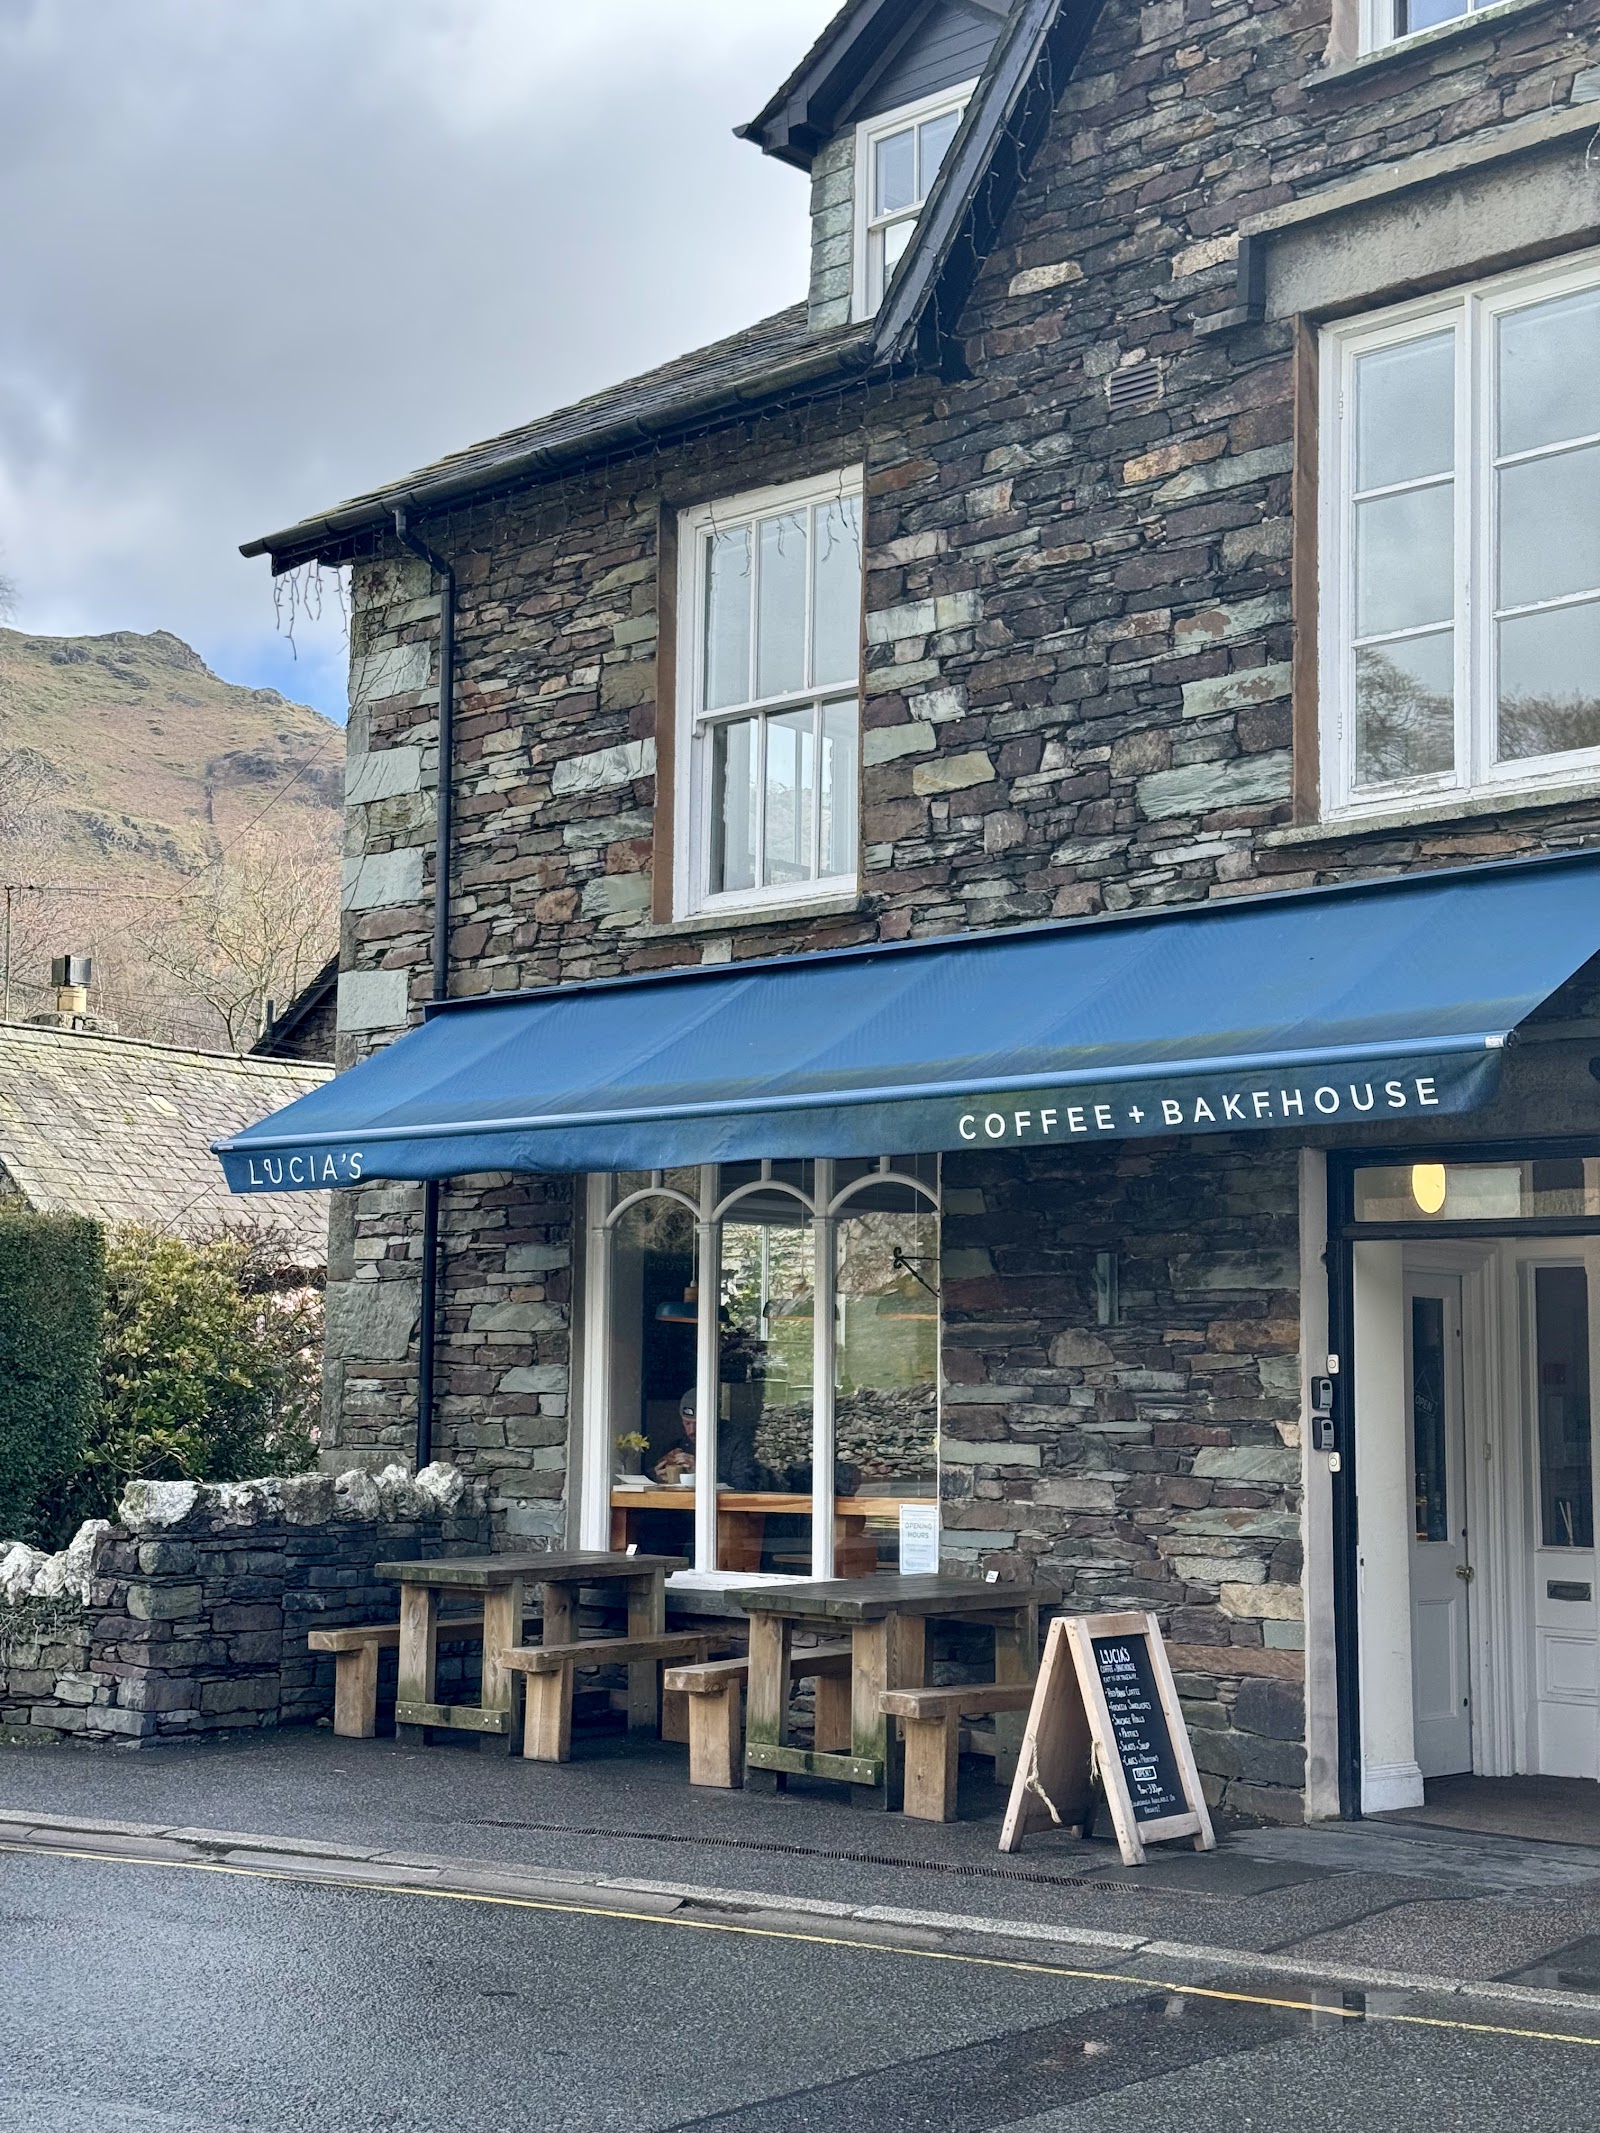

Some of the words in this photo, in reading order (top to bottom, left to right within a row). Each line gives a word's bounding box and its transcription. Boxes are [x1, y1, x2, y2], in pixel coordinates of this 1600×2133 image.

[958, 1103, 1116, 1141] COFFEE
[1128, 1104, 1146, 1125] +
[1161, 1076, 1441, 1127] BAKEHOUSE
[248, 1152, 364, 1185] LUCIA'S
[1415, 1394, 1434, 1412] OPEN
[904, 1522, 932, 1530] OPENING
[907, 1531, 929, 1539] HOURS
[1099, 1646, 1130, 1664] LUCIA'S
